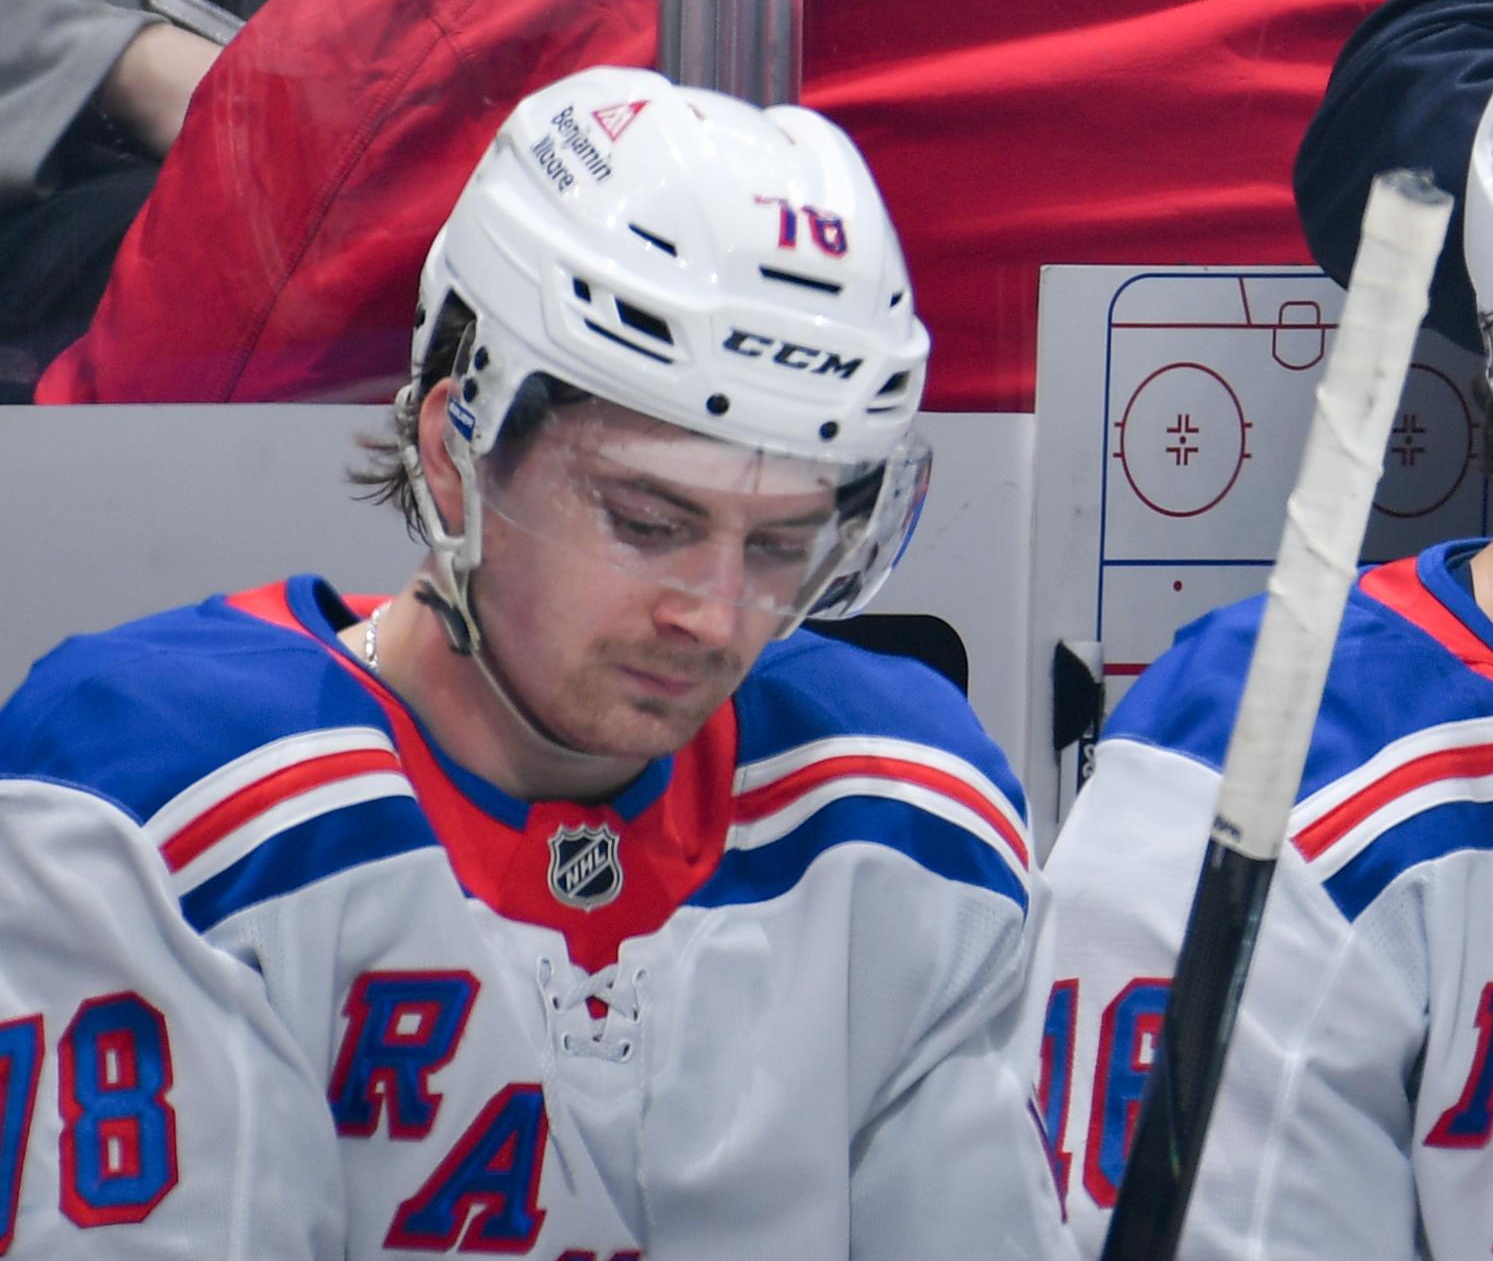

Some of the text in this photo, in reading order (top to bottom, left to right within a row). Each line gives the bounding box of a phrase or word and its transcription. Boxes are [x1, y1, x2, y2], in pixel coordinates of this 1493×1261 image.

[551, 104, 612, 182] Benjamin
[722, 328, 865, 380] CCM
[565, 846, 607, 892] NHL
[327, 969, 642, 1261] RA
